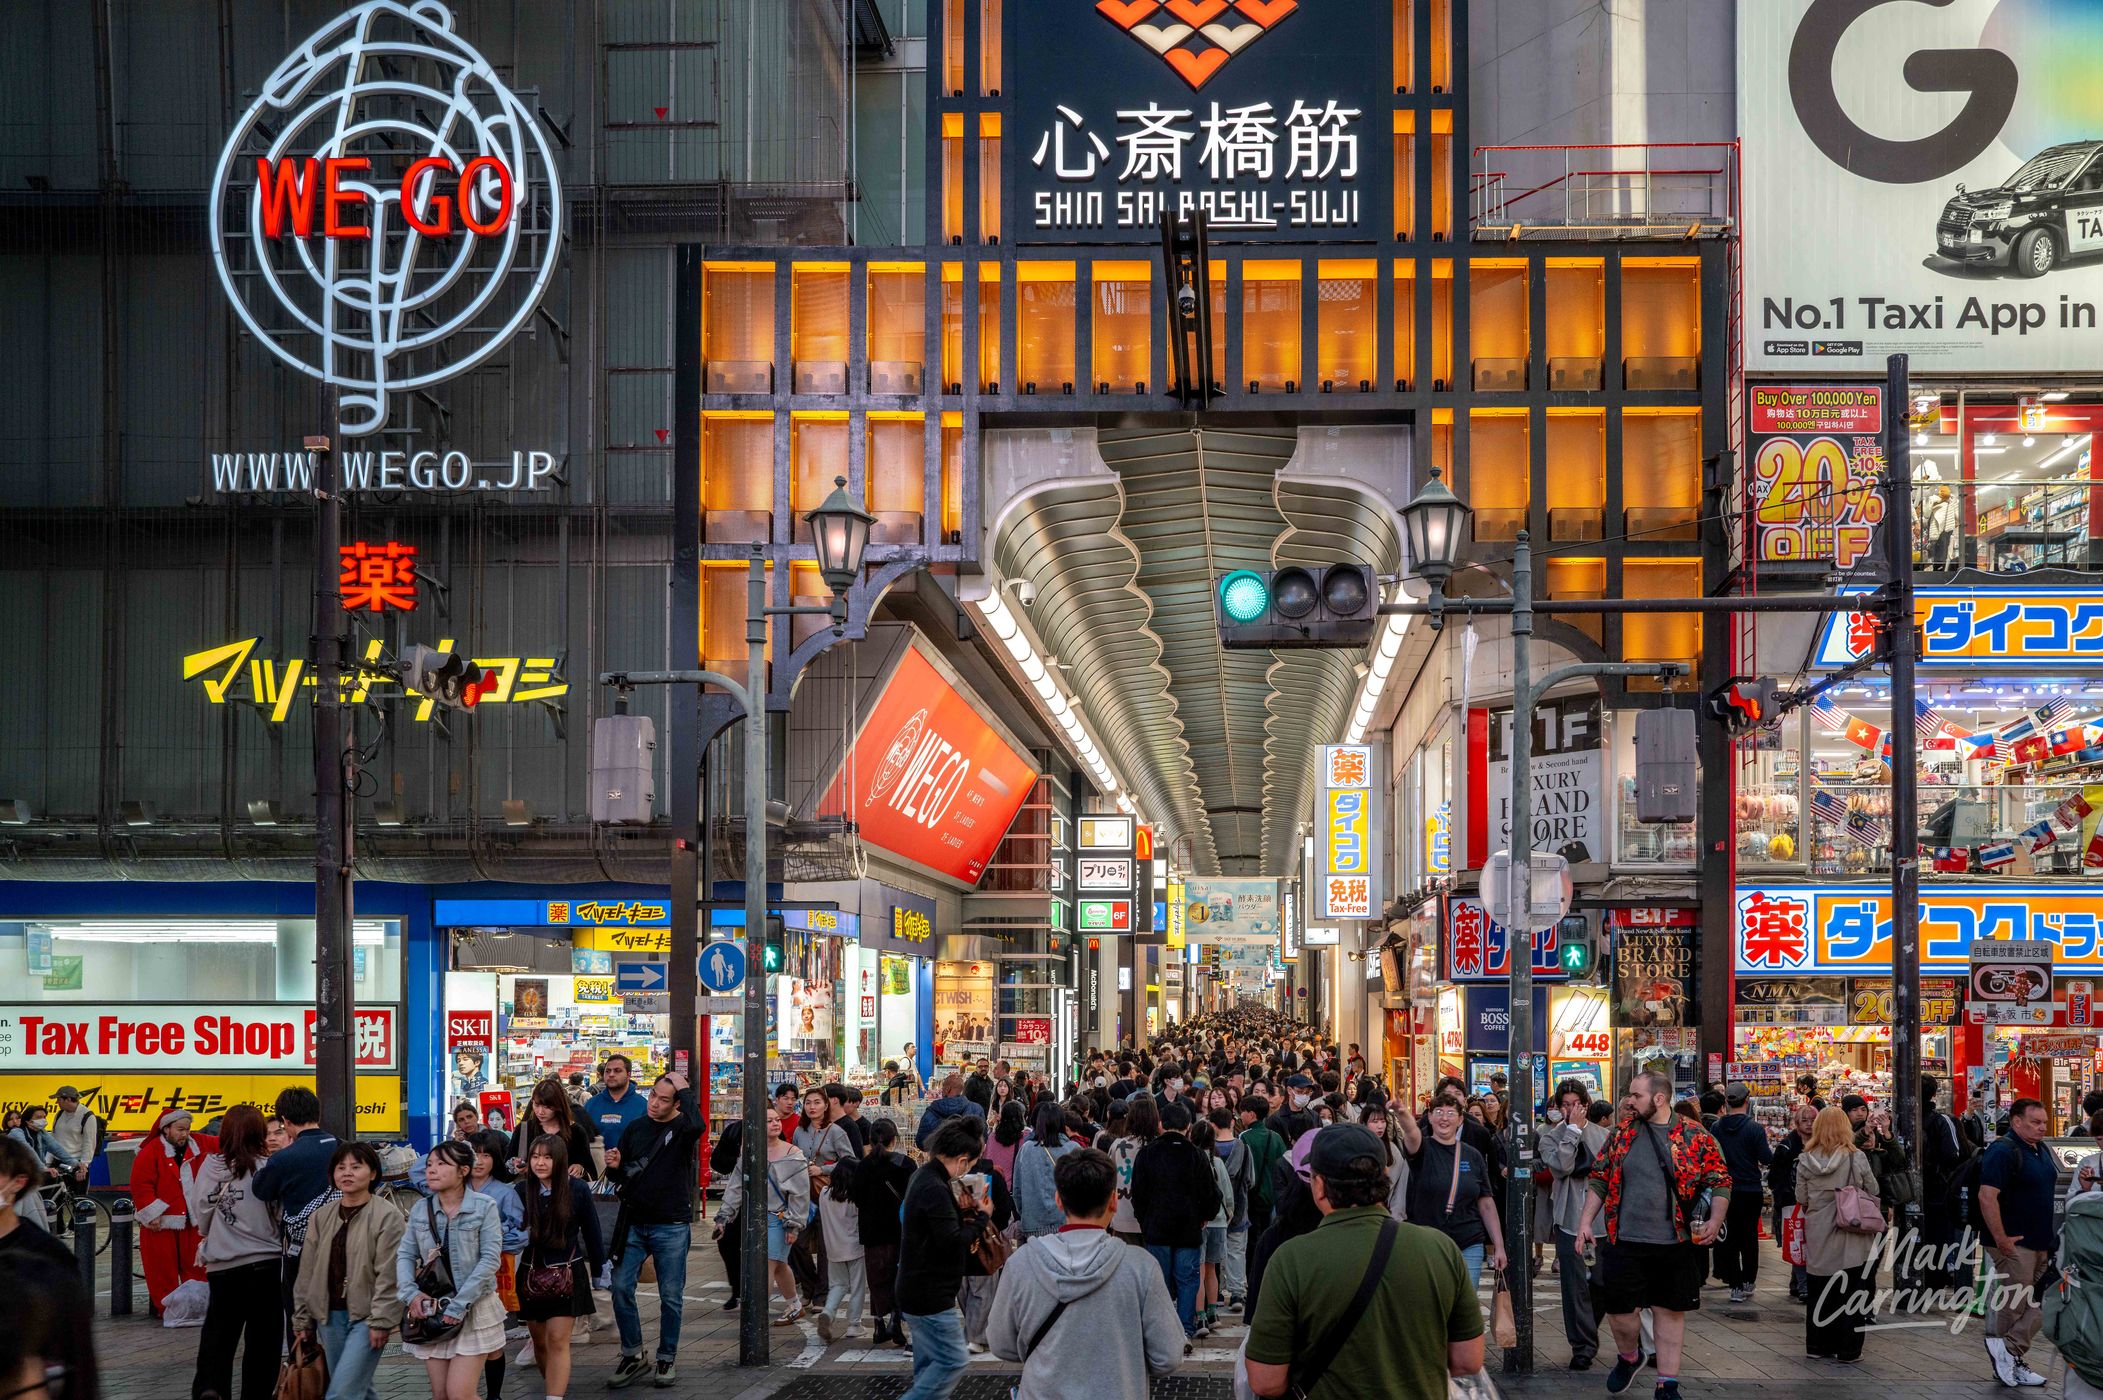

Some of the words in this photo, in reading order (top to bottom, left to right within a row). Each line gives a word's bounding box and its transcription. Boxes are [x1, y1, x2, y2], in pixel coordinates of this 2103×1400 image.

[1788, 0, 2019, 184] G
[1032, 100, 1363, 183] 心斎橋筋
[257, 157, 372, 240] WE
[400, 157, 514, 238] GO
[1035, 191, 1103, 226] SHIN
[1764, 297, 1846, 330] No.1
[1858, 296, 1943, 330] Taxi
[1955, 296, 2046, 335] App
[2059, 295, 2096, 328] in
[1827, 347, 1848, 355] Google
[1849, 347, 1860, 355] Play
[1757, 391, 1778, 406] Buy
[1781, 391, 1807, 405] Over
[1811, 391, 1853, 406] 100,000
[1854, 391, 1877, 405] Yen
[1776, 420, 1816, 430] 100,000엔
[1853, 437, 1876, 447] TAX
[1853, 447, 1882, 456] FREE
[1761, 525, 1873, 569] OFF
[340, 540, 420, 612] 薬
[1333, 748, 1365, 785] 薬
[1545, 758, 1570, 768] Second
[1571, 757, 1588, 766] hand
[888, 728, 970, 829] WEGO
[1530, 770, 1582, 791] XURY
[1500, 789, 1589, 819] AND
[1335, 793, 1361, 871] ダイコク
[1329, 879, 1368, 903] 免税
[549, 903, 567, 922] 薬
[576, 902, 666, 924] マツモトキヨシ
[1113, 911, 1126, 920] 6F
[1329, 904, 1368, 913] Tax-Free
[1630, 908, 1679, 924] B1F
[1454, 902, 1482, 972] 薬
[1741, 892, 1807, 967] 薬
[1825, 900, 2103, 959] ダコクドラ
[1624, 935, 1685, 946] LUXURY
[1617, 947, 1692, 962] BRAND
[1974, 947, 2049, 958] 自転車放置禁止区域
[1617, 963, 1691, 978] STORE
[946, 991, 972, 1005] WISH
[1090, 969, 1098, 1011] McDonald's
[1750, 984, 1801, 999] NMN
[450, 1018, 490, 1036] SK-II
[1480, 1012, 1510, 1025] BOSS
[19, 1016, 90, 1056] Tax
[98, 1016, 185, 1056] Free
[193, 1015, 295, 1060] Shop
[309, 1015, 387, 1059] 税
[1743, 1064, 1778, 1074] ダイコク
[1, 1101, 59, 1115] KiYhi
